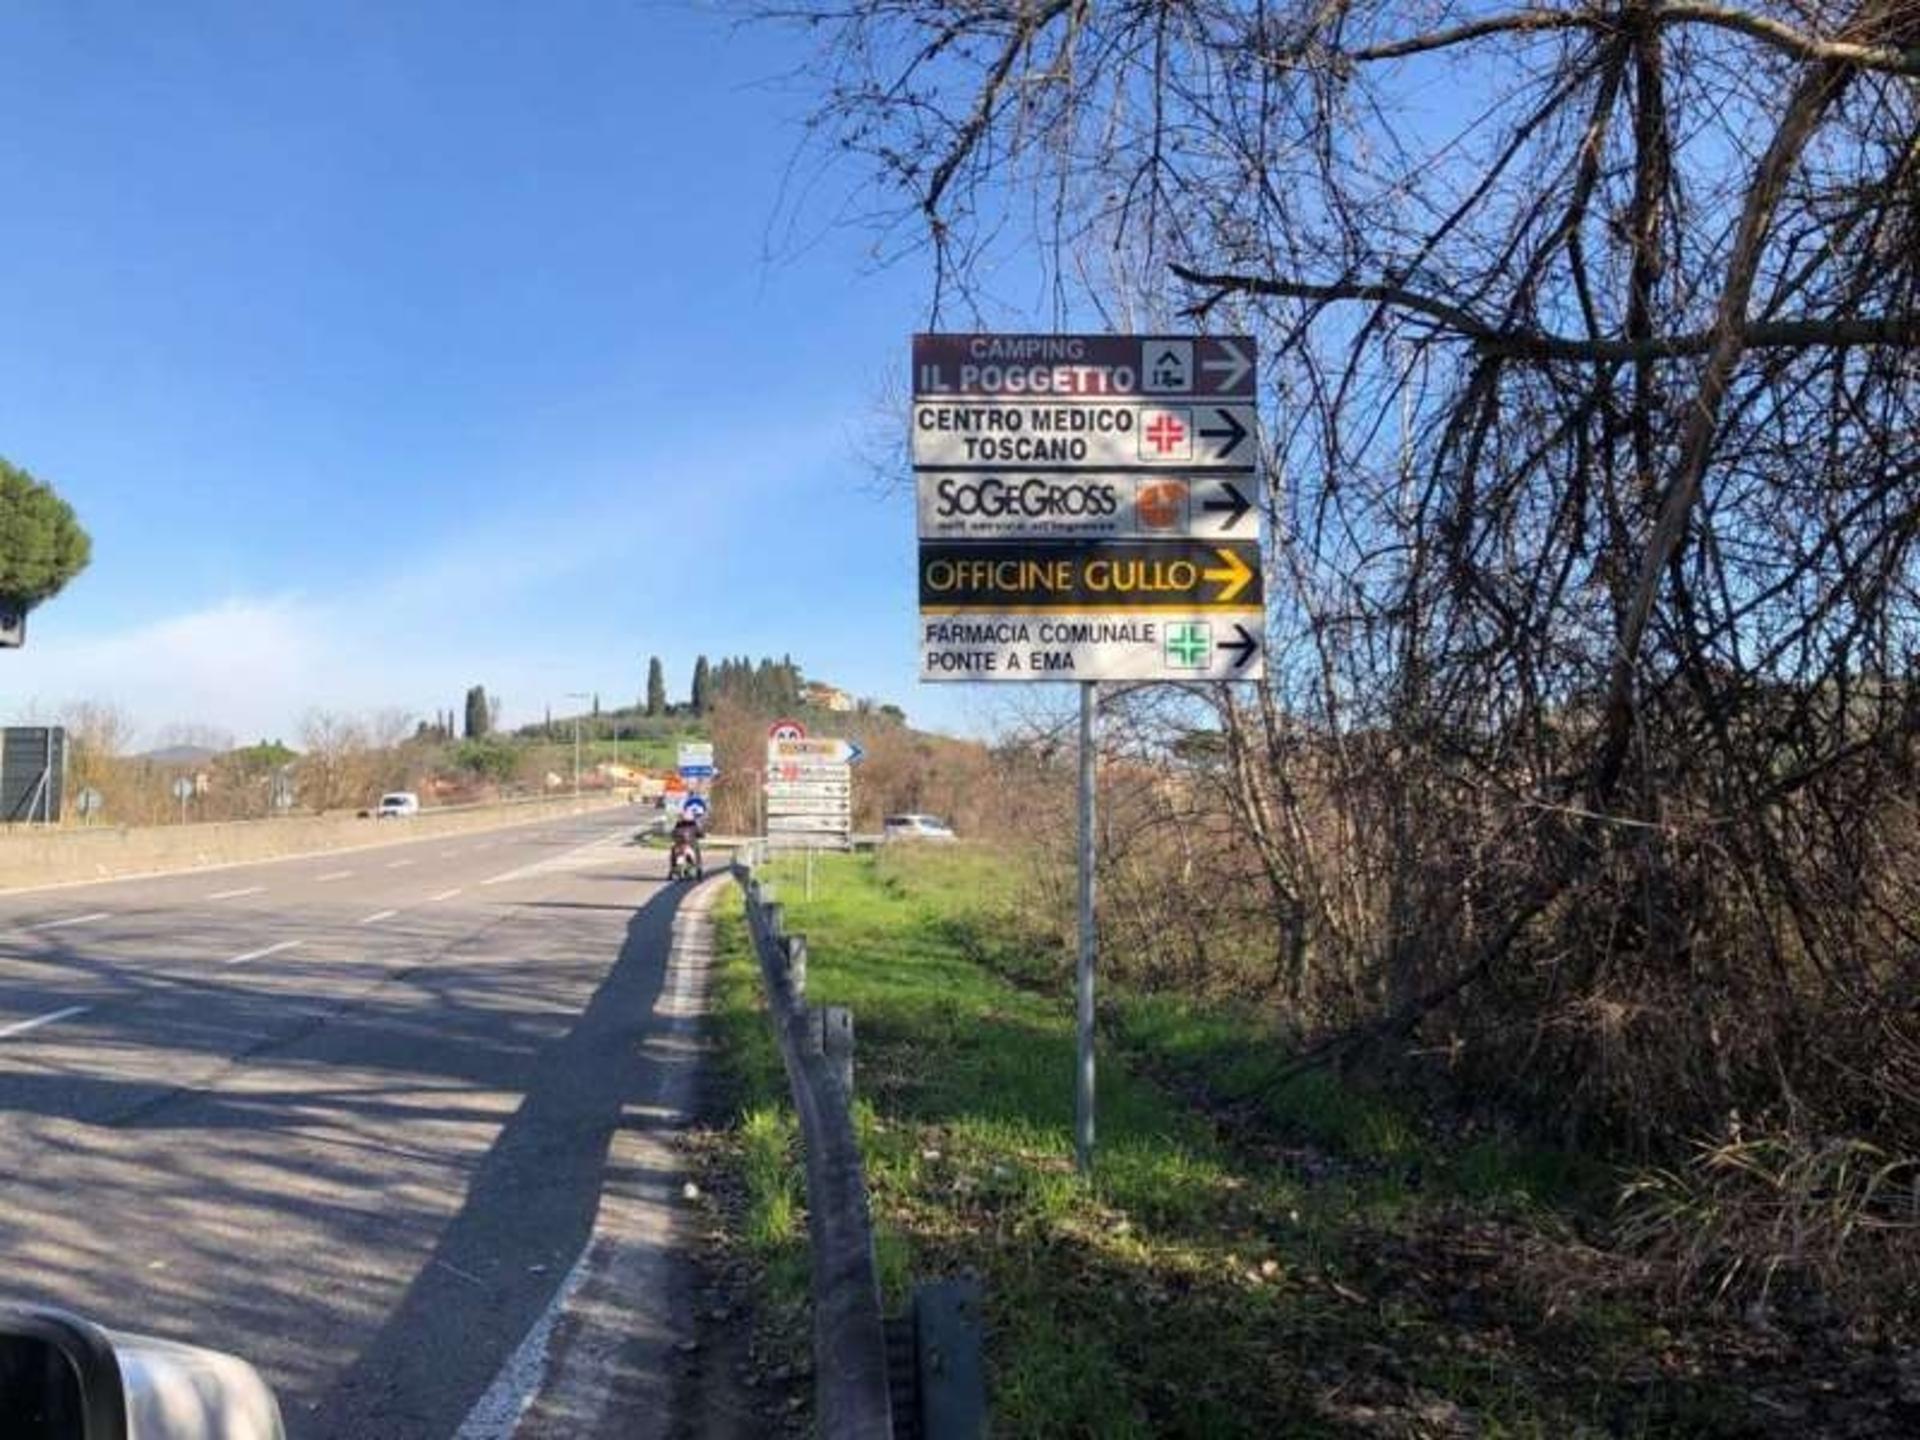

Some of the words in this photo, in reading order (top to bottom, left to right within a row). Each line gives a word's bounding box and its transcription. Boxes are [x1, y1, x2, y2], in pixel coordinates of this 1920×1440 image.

[971, 339, 1084, 359] CAMPING
[921, 366, 948, 391] IL
[960, 365, 1135, 392] POGGETTO
[918, 408, 1022, 432] CENTRO
[1032, 408, 1133, 431] MEDICO
[964, 437, 1087, 461] TOSCANO
[926, 559, 1073, 592] OFFICINE
[1084, 560, 1197, 592] GULLO
[926, 624, 1029, 644] FARMACIA
[1039, 623, 1155, 644] COMUNALE
[927, 652, 996, 671] PONTE
[1007, 652, 1021, 670] A
[1031, 652, 1076, 670] EMA
